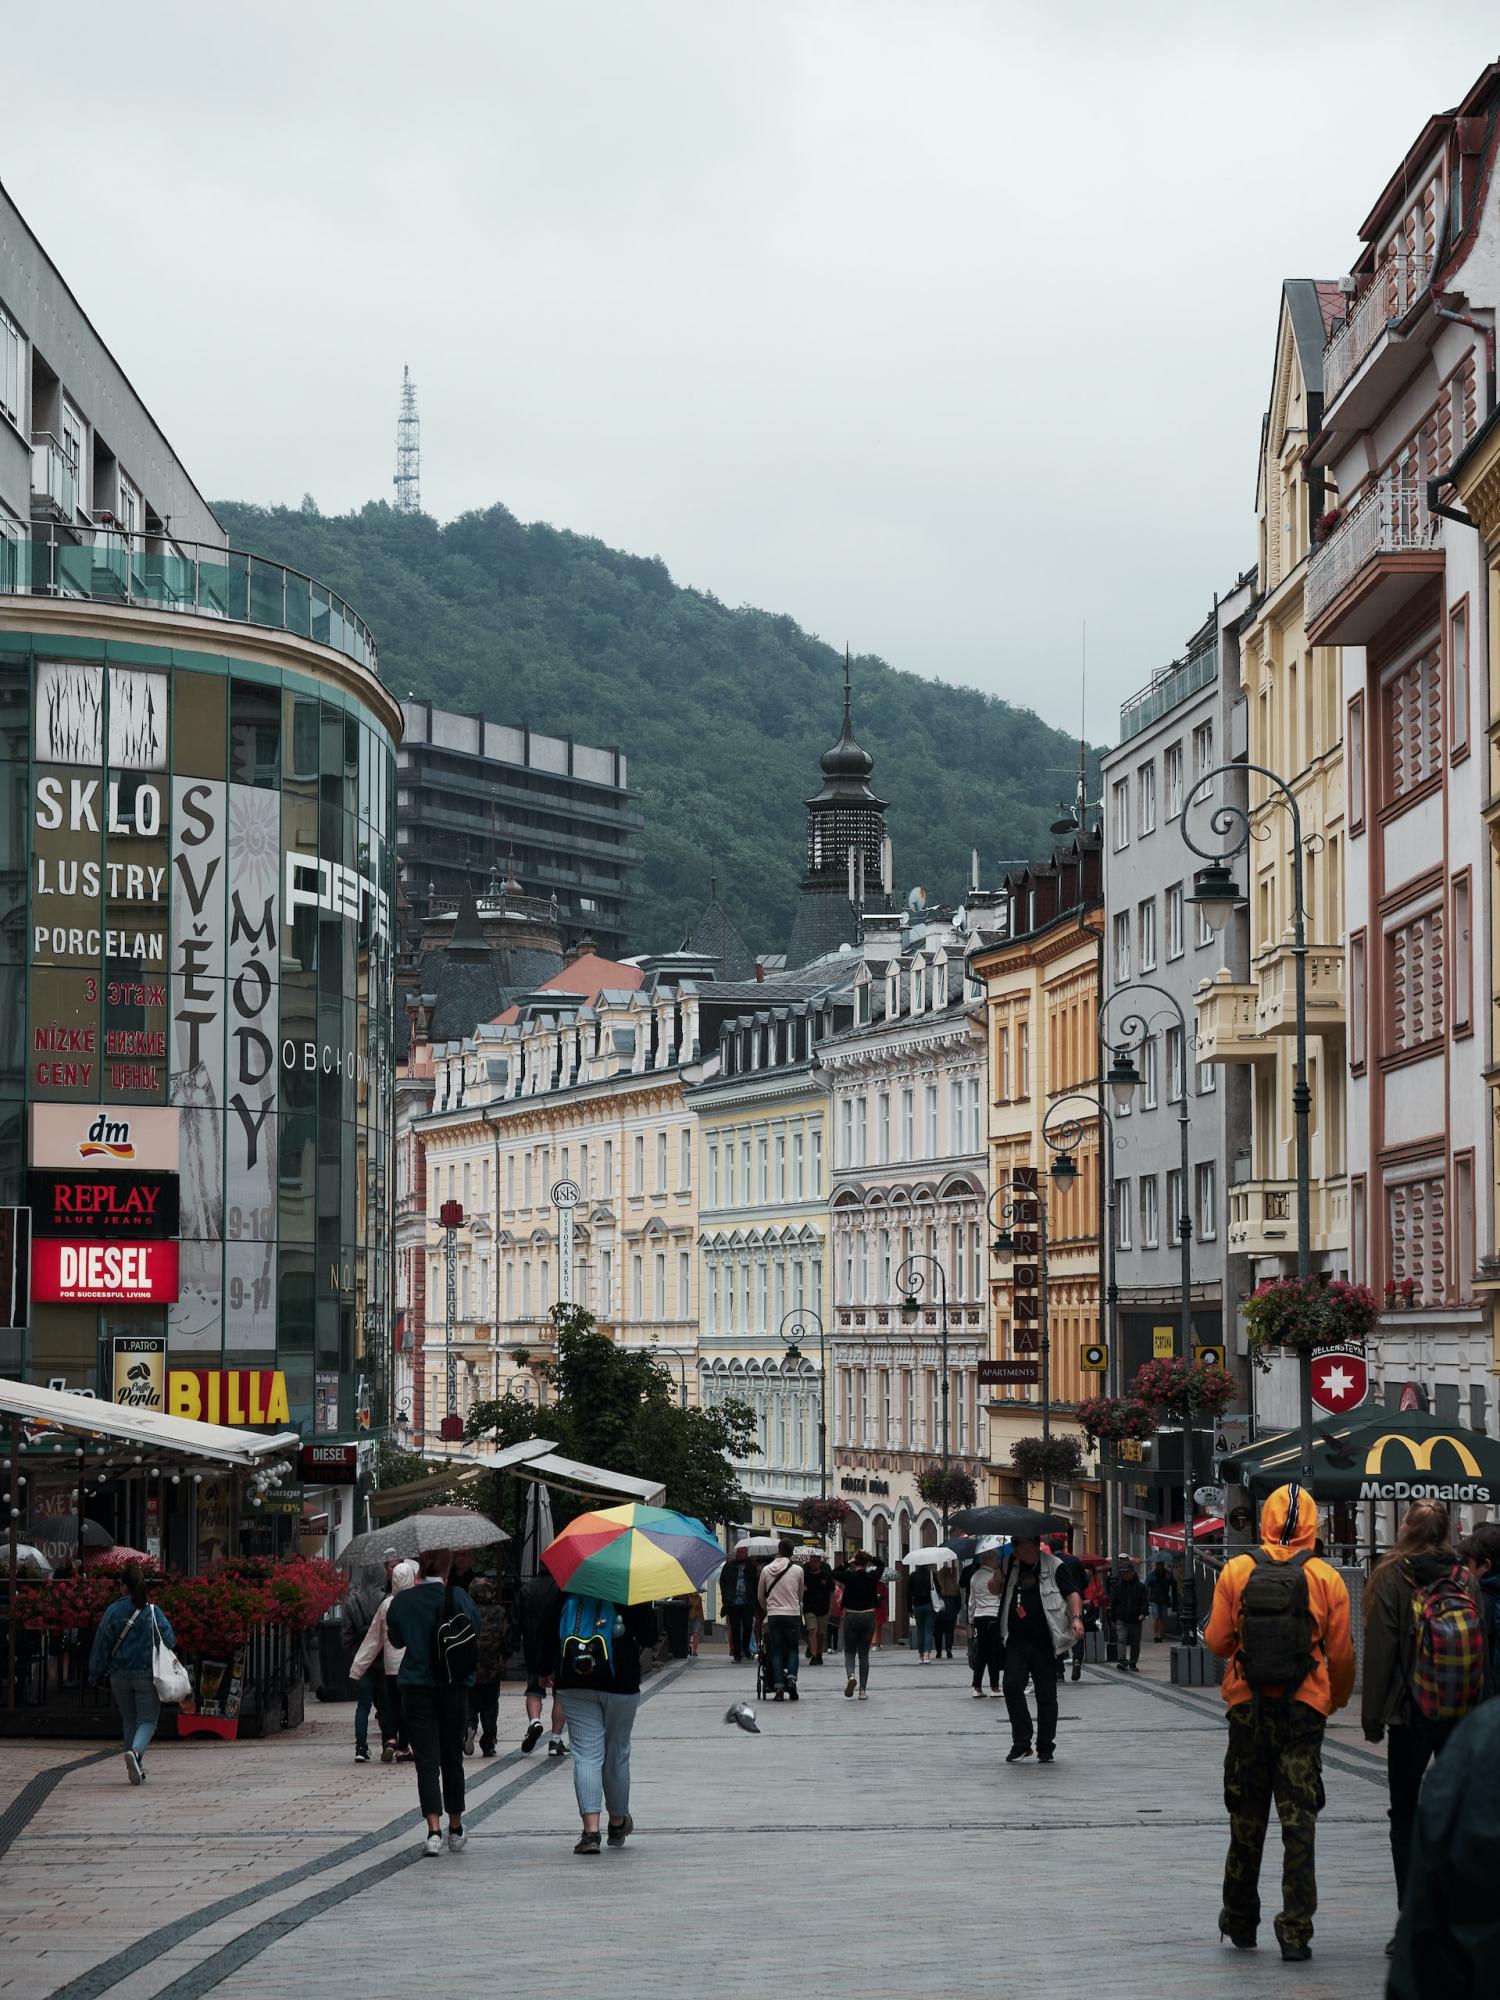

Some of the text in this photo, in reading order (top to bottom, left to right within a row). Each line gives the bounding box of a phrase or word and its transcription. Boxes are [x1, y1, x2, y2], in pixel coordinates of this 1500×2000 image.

[36, 776, 160, 836] SKLO
[38, 859, 166, 902] LUSTRY
[34, 926, 163, 960] PORCELAN
[172, 784, 222, 1074] SVĚT
[83, 976, 97, 1004] 3
[34, 1020, 96, 1054] NÍZKÉ
[229, 888, 276, 1171] MÓDY
[36, 1061, 95, 1088] CENY
[88, 1114, 130, 1142] dm
[53, 1183, 161, 1213] REPLAY
[54, 1215, 153, 1224] BLUE JEANS
[60, 1246, 153, 1289] DIESEL
[1017, 1170, 1036, 1350] VERONA
[126, 1291, 152, 1299] LIVING
[981, 1368, 1036, 1377] APARTMENTS
[117, 1386, 161, 1406] Perla
[168, 1370, 290, 1424] BILLA
[312, 1448, 347, 1461] DIESEL
[1359, 1481, 1491, 1501] McDonald's
